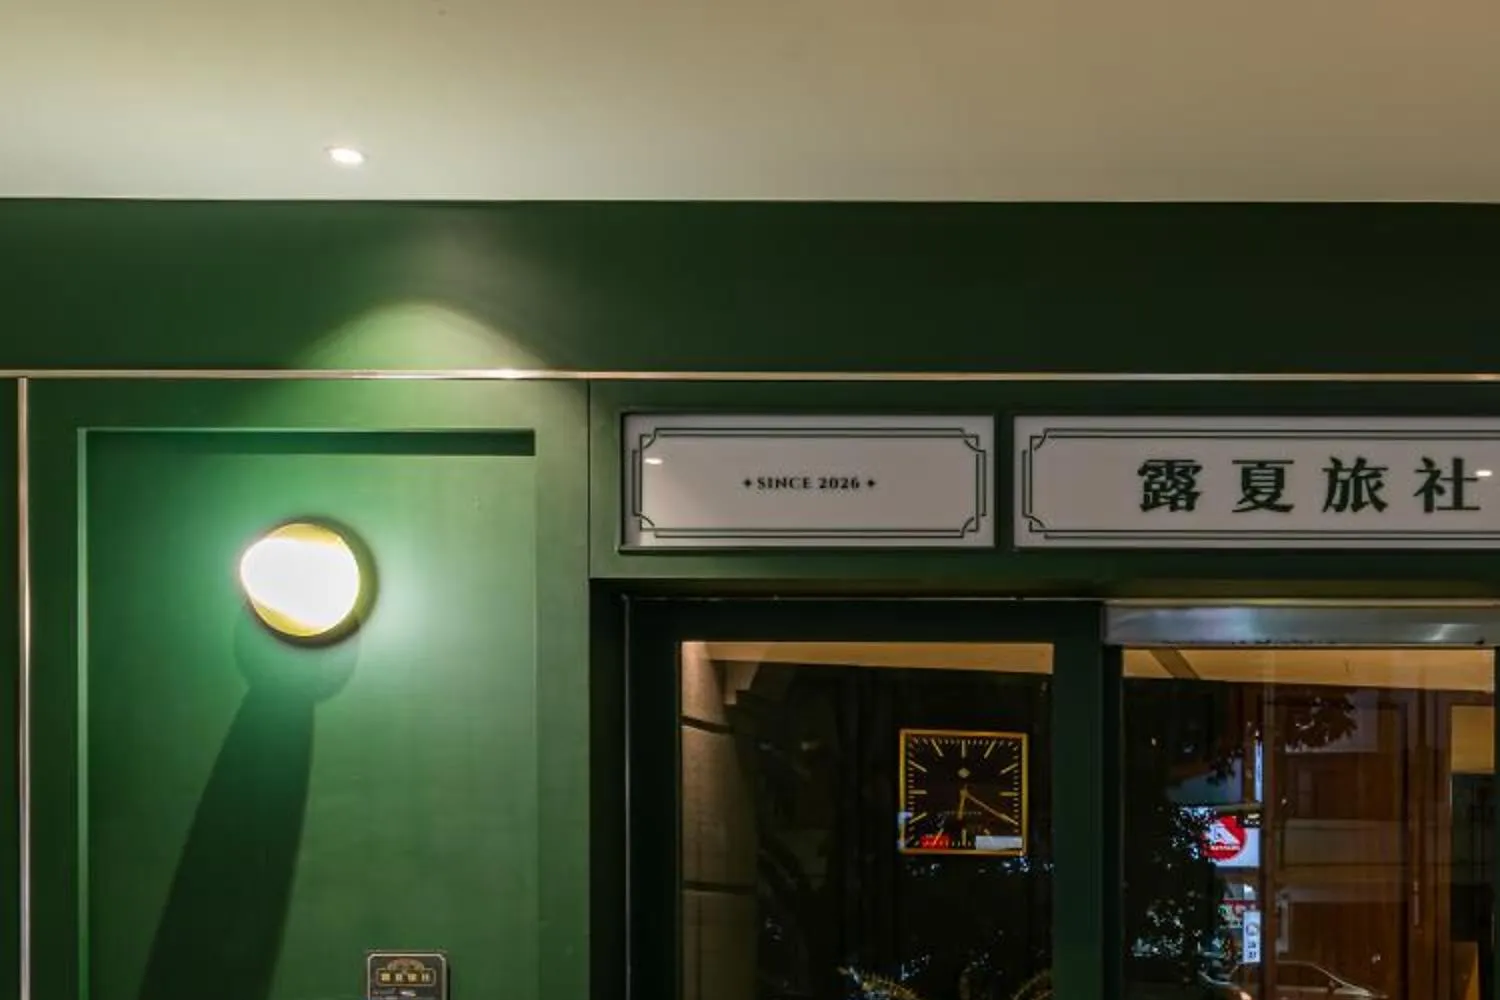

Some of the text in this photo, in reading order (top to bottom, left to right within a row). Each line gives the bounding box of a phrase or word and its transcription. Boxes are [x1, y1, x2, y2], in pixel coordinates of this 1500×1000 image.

[756, 476, 812, 491] SINCE
[1136, 456, 1482, 514] 露夏旅社
